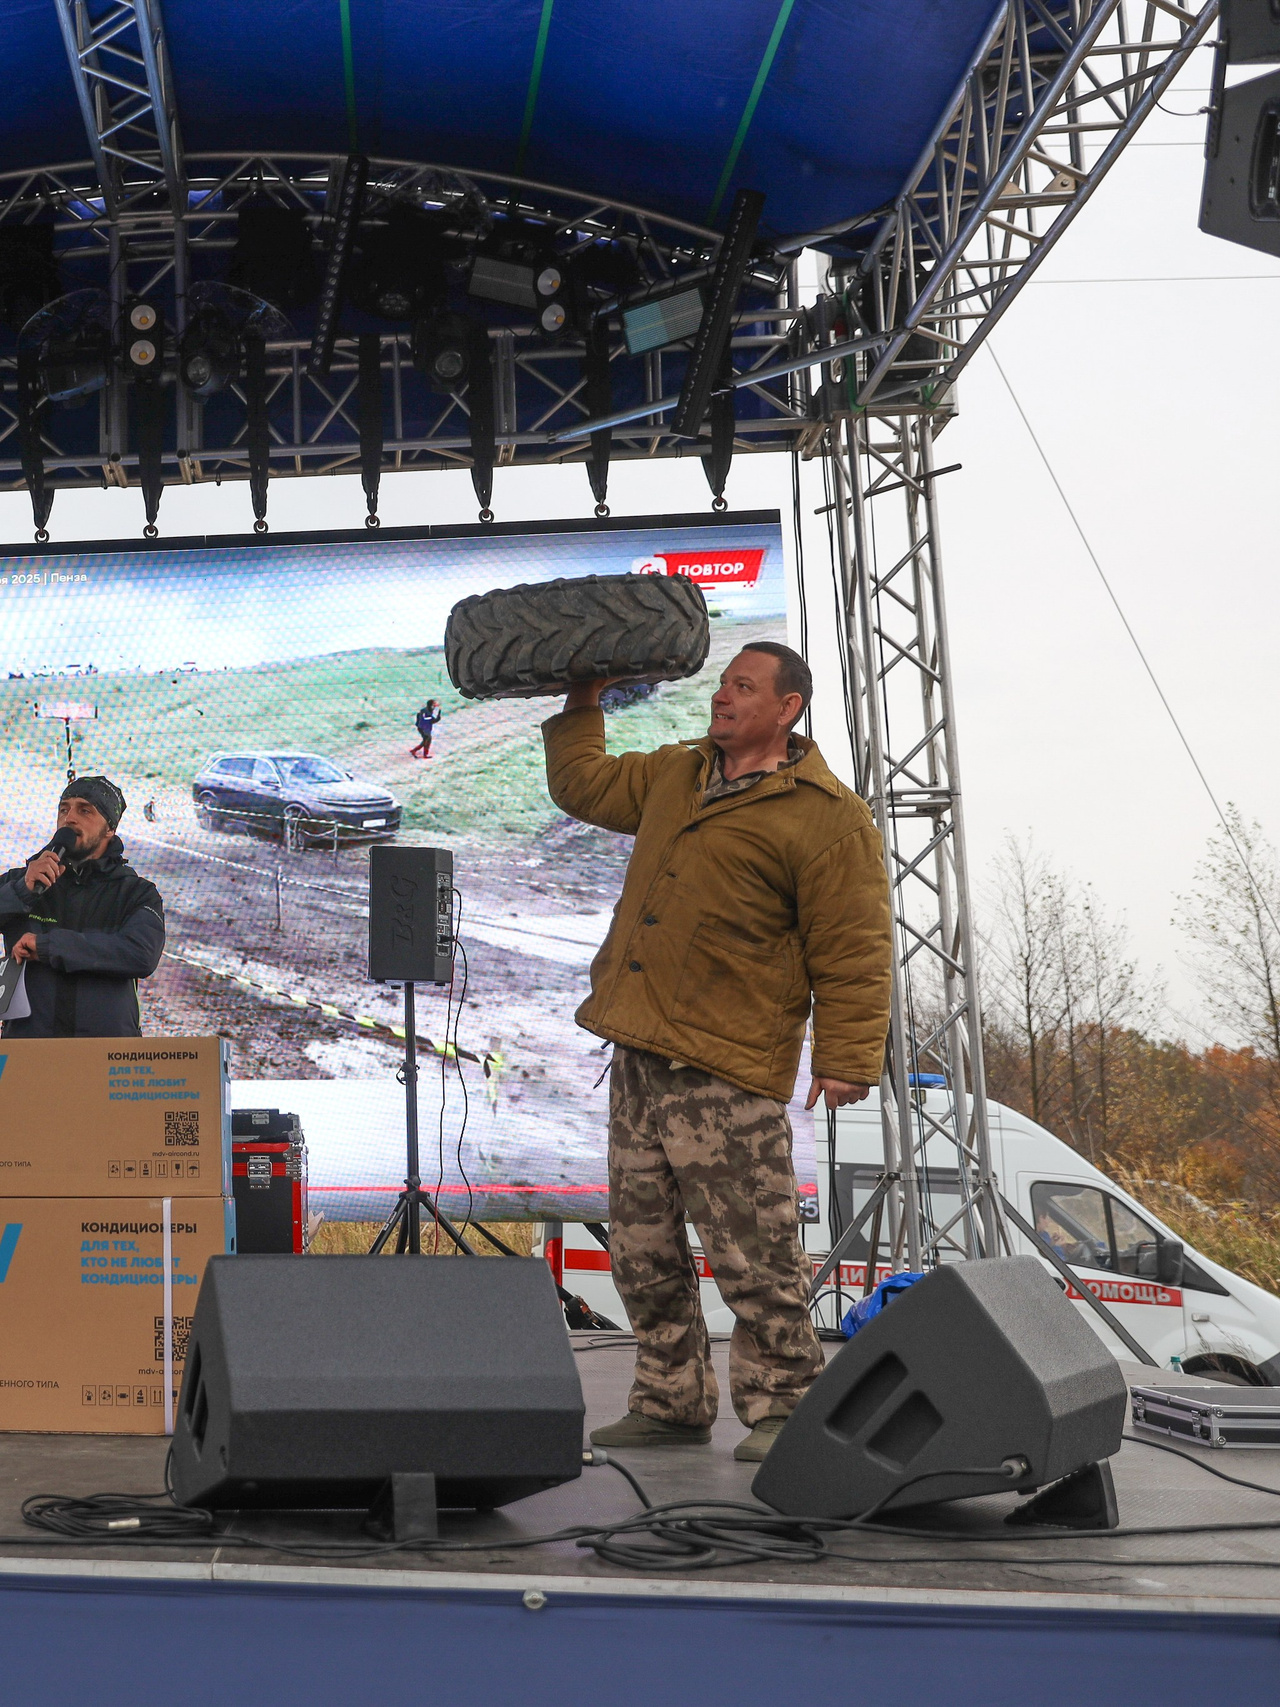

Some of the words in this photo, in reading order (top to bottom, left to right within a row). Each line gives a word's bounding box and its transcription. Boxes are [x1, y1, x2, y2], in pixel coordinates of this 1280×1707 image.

[677, 562, 744, 577] ПОВТОР
[11, 573, 41, 584] 2025
[50, 573, 87, 583] Пенза
[107, 1051, 199, 1061] КОНДИЦИОНЕРЫ
[108, 1066, 131, 1076] ДЛЯ
[133, 1066, 155, 1076] ТЕХ,
[109, 1079, 130, 1088] КТО
[132, 1079, 145, 1088] НЕ
[147, 1078, 187, 1087] ЛЮБИТ
[109, 1091, 200, 1101] КОНДИЦИОНЕРЫ
[80, 1240, 109, 1252] ДЛЯ
[112, 1240, 140, 1253] ТЕХ,
[81, 1257, 108, 1268] КТО
[111, 1257, 128, 1268] НЕ
[130, 1257, 180, 1268] ЛЮБТ
[37, 1380, 60, 1389] ТИПА
